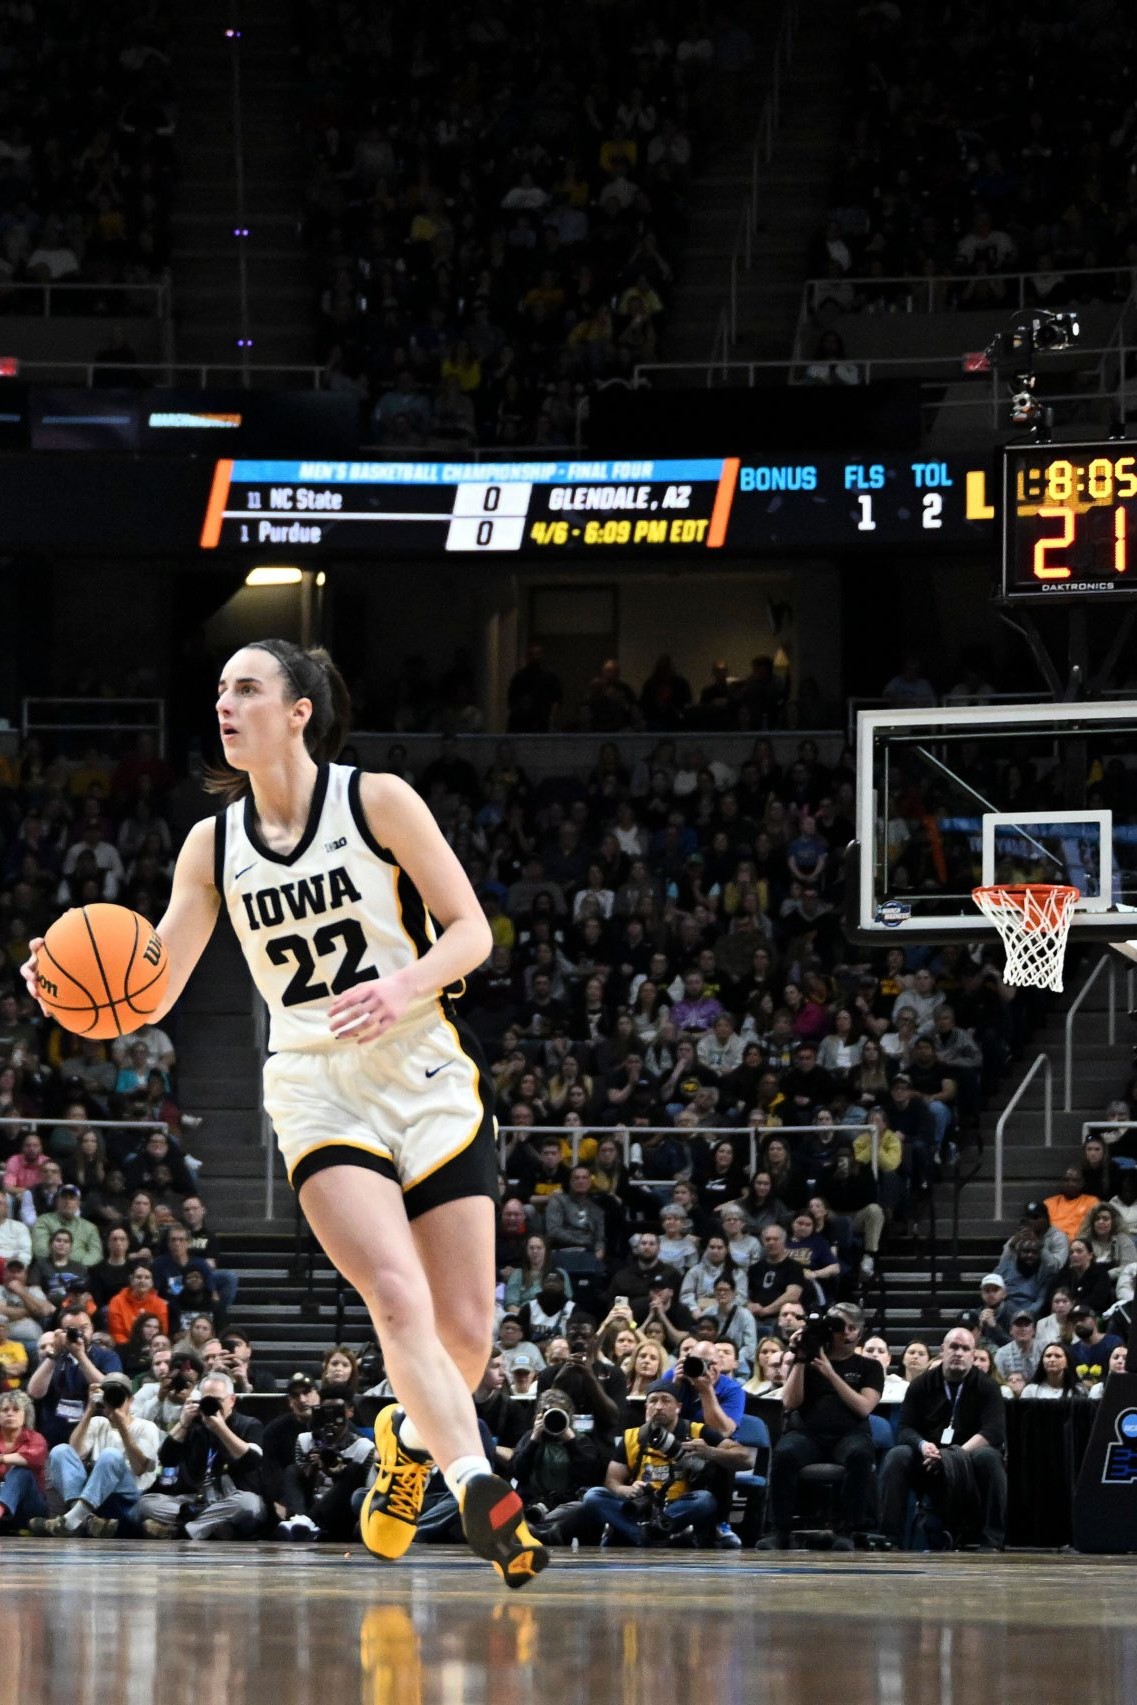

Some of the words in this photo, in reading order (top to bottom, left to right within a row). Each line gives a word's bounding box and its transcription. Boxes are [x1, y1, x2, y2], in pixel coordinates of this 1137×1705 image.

[300, 462, 346, 481] MEN'S
[350, 462, 439, 481] BASKETBALL
[442, 463, 556, 481] CHAMPIONSHIP
[567, 463, 608, 480] FINAL
[613, 461, 654, 480] FOUR
[740, 466, 817, 491] BONUS
[844, 465, 885, 489] FLS
[911, 463, 953, 487] TOL
[270, 488, 293, 510] NC
[296, 488, 343, 510] State
[483, 486, 501, 512] 0
[663, 486, 692, 509] AZ
[858, 495, 876, 531] 1
[922, 493, 942, 529] 2
[259, 521, 322, 544] Purdue
[476, 520, 494, 546] 0
[530, 521, 569, 544] 4/6
[584, 520, 630, 544] 6:09
[634, 520, 667, 543] PM
[670, 519, 709, 543] EDT
[1033, 505, 1127, 579] 21
[1041, 582, 1115, 592] DAKTRONICS
[242, 866, 362, 931] IOWA
[265, 918, 380, 1007] 22
